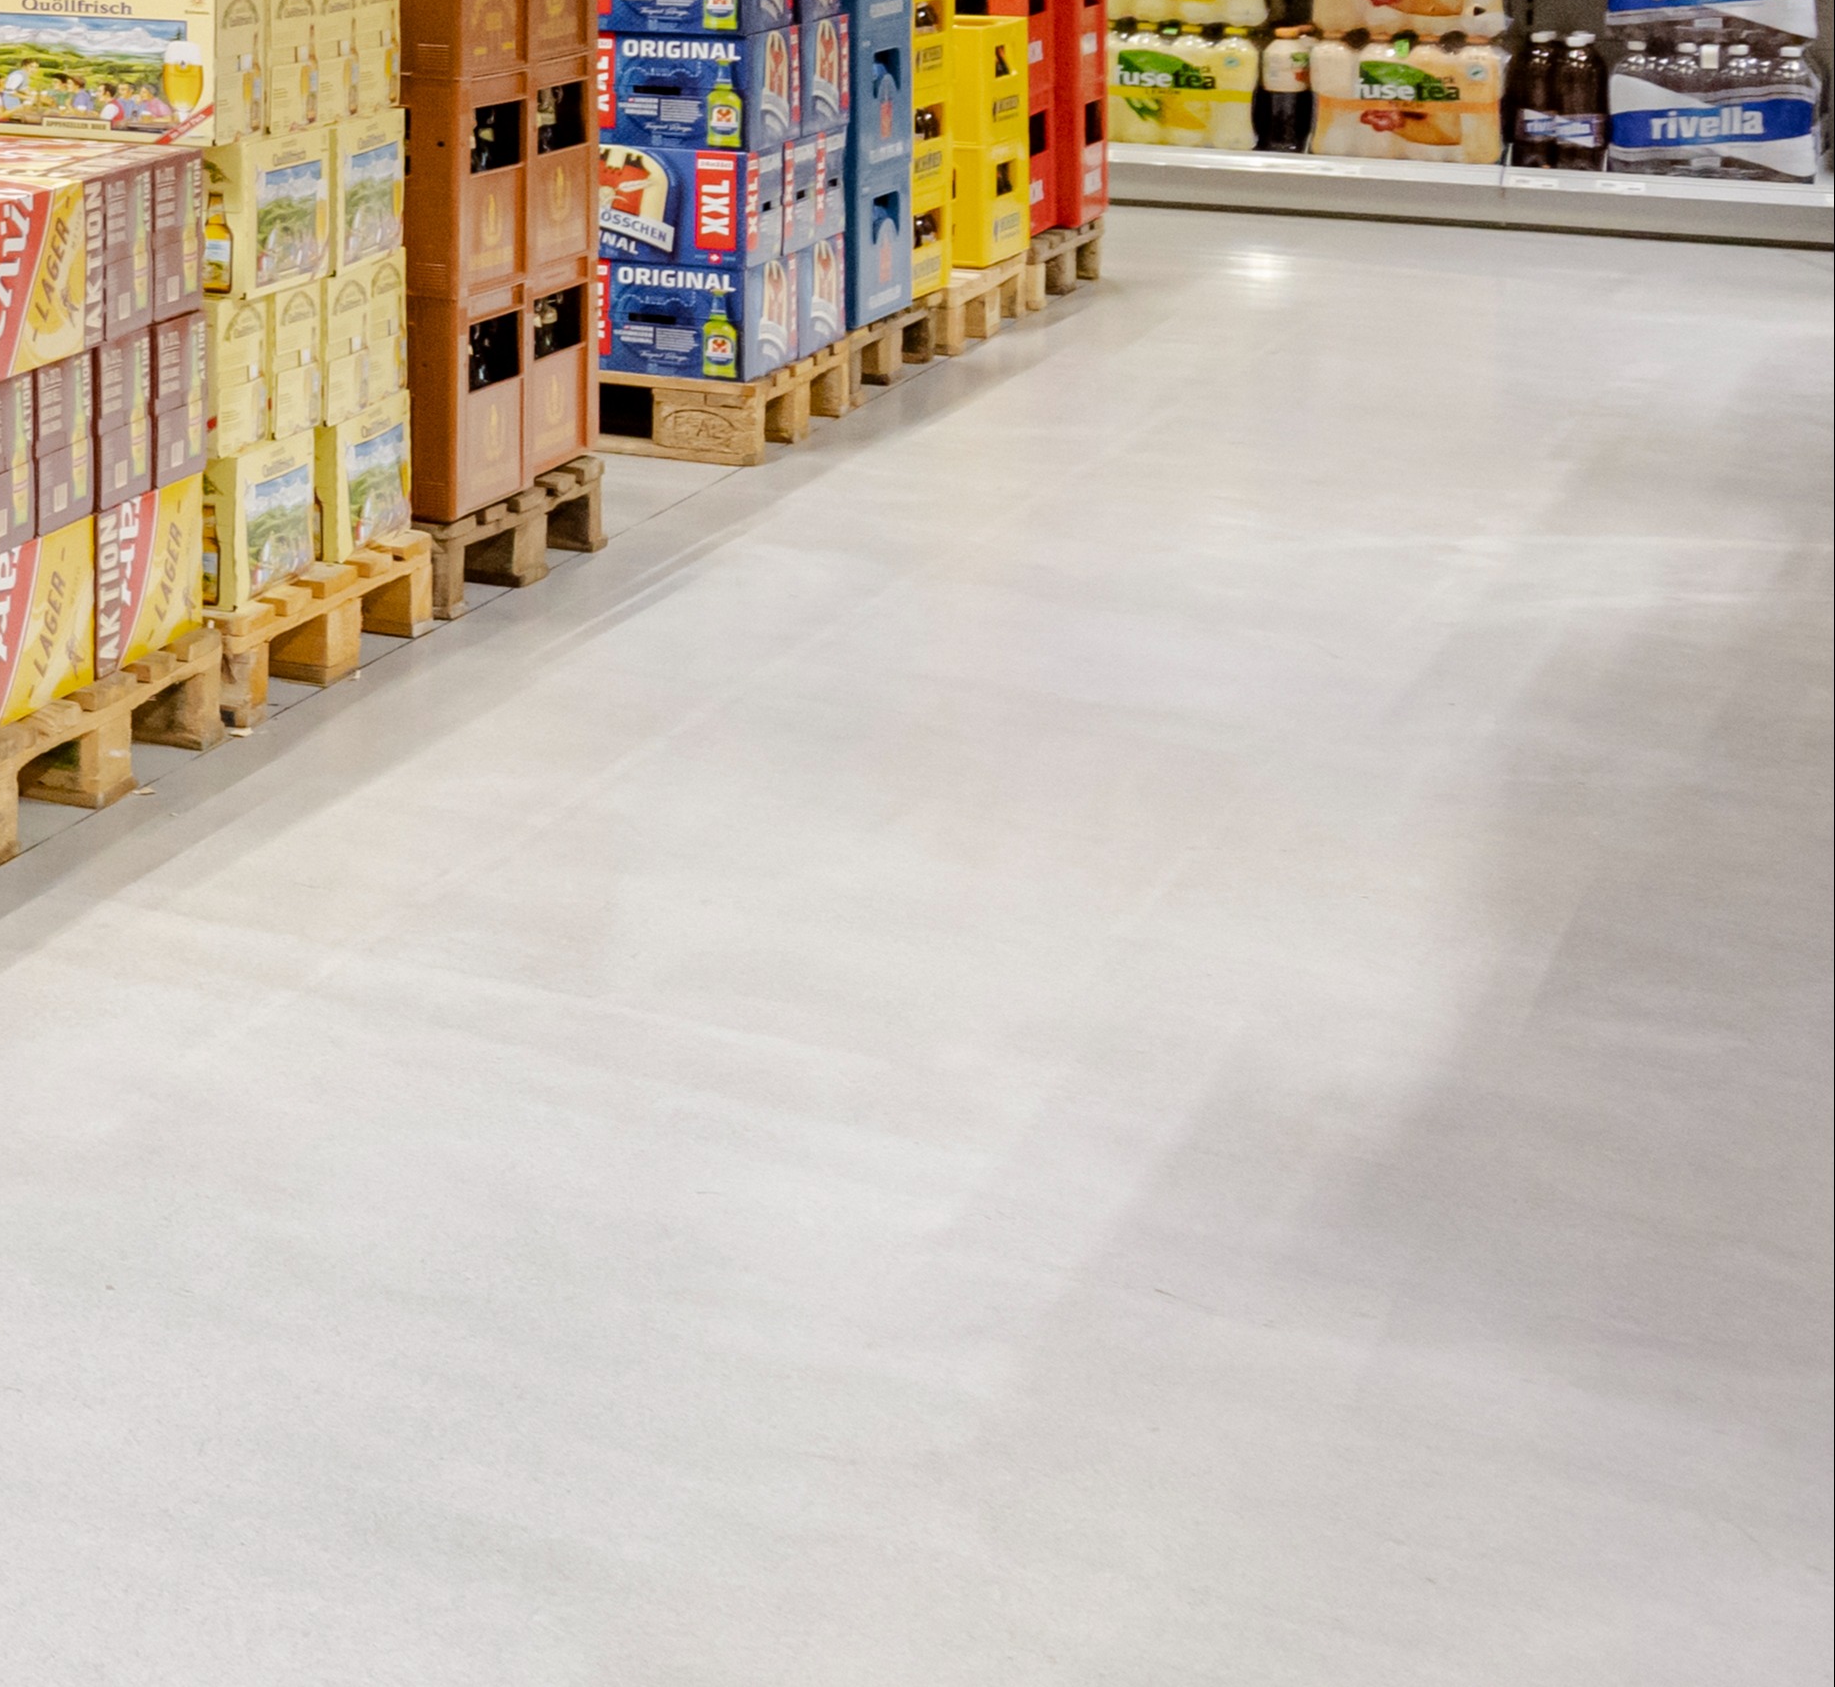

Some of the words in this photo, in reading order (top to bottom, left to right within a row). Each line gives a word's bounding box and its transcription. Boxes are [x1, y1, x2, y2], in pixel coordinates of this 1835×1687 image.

[622, 38, 741, 60] ORIGINAL
[1651, 105, 1764, 140] rivella
[701, 179, 730, 237] XXL
[34, 216, 71, 322] LAGER
[84, 180, 104, 347] AKTION
[617, 265, 737, 293] ORIGINAL
[98, 512, 120, 663] AKTION
[155, 521, 183, 622] LAGER
[33, 569, 67, 679] LAGER
